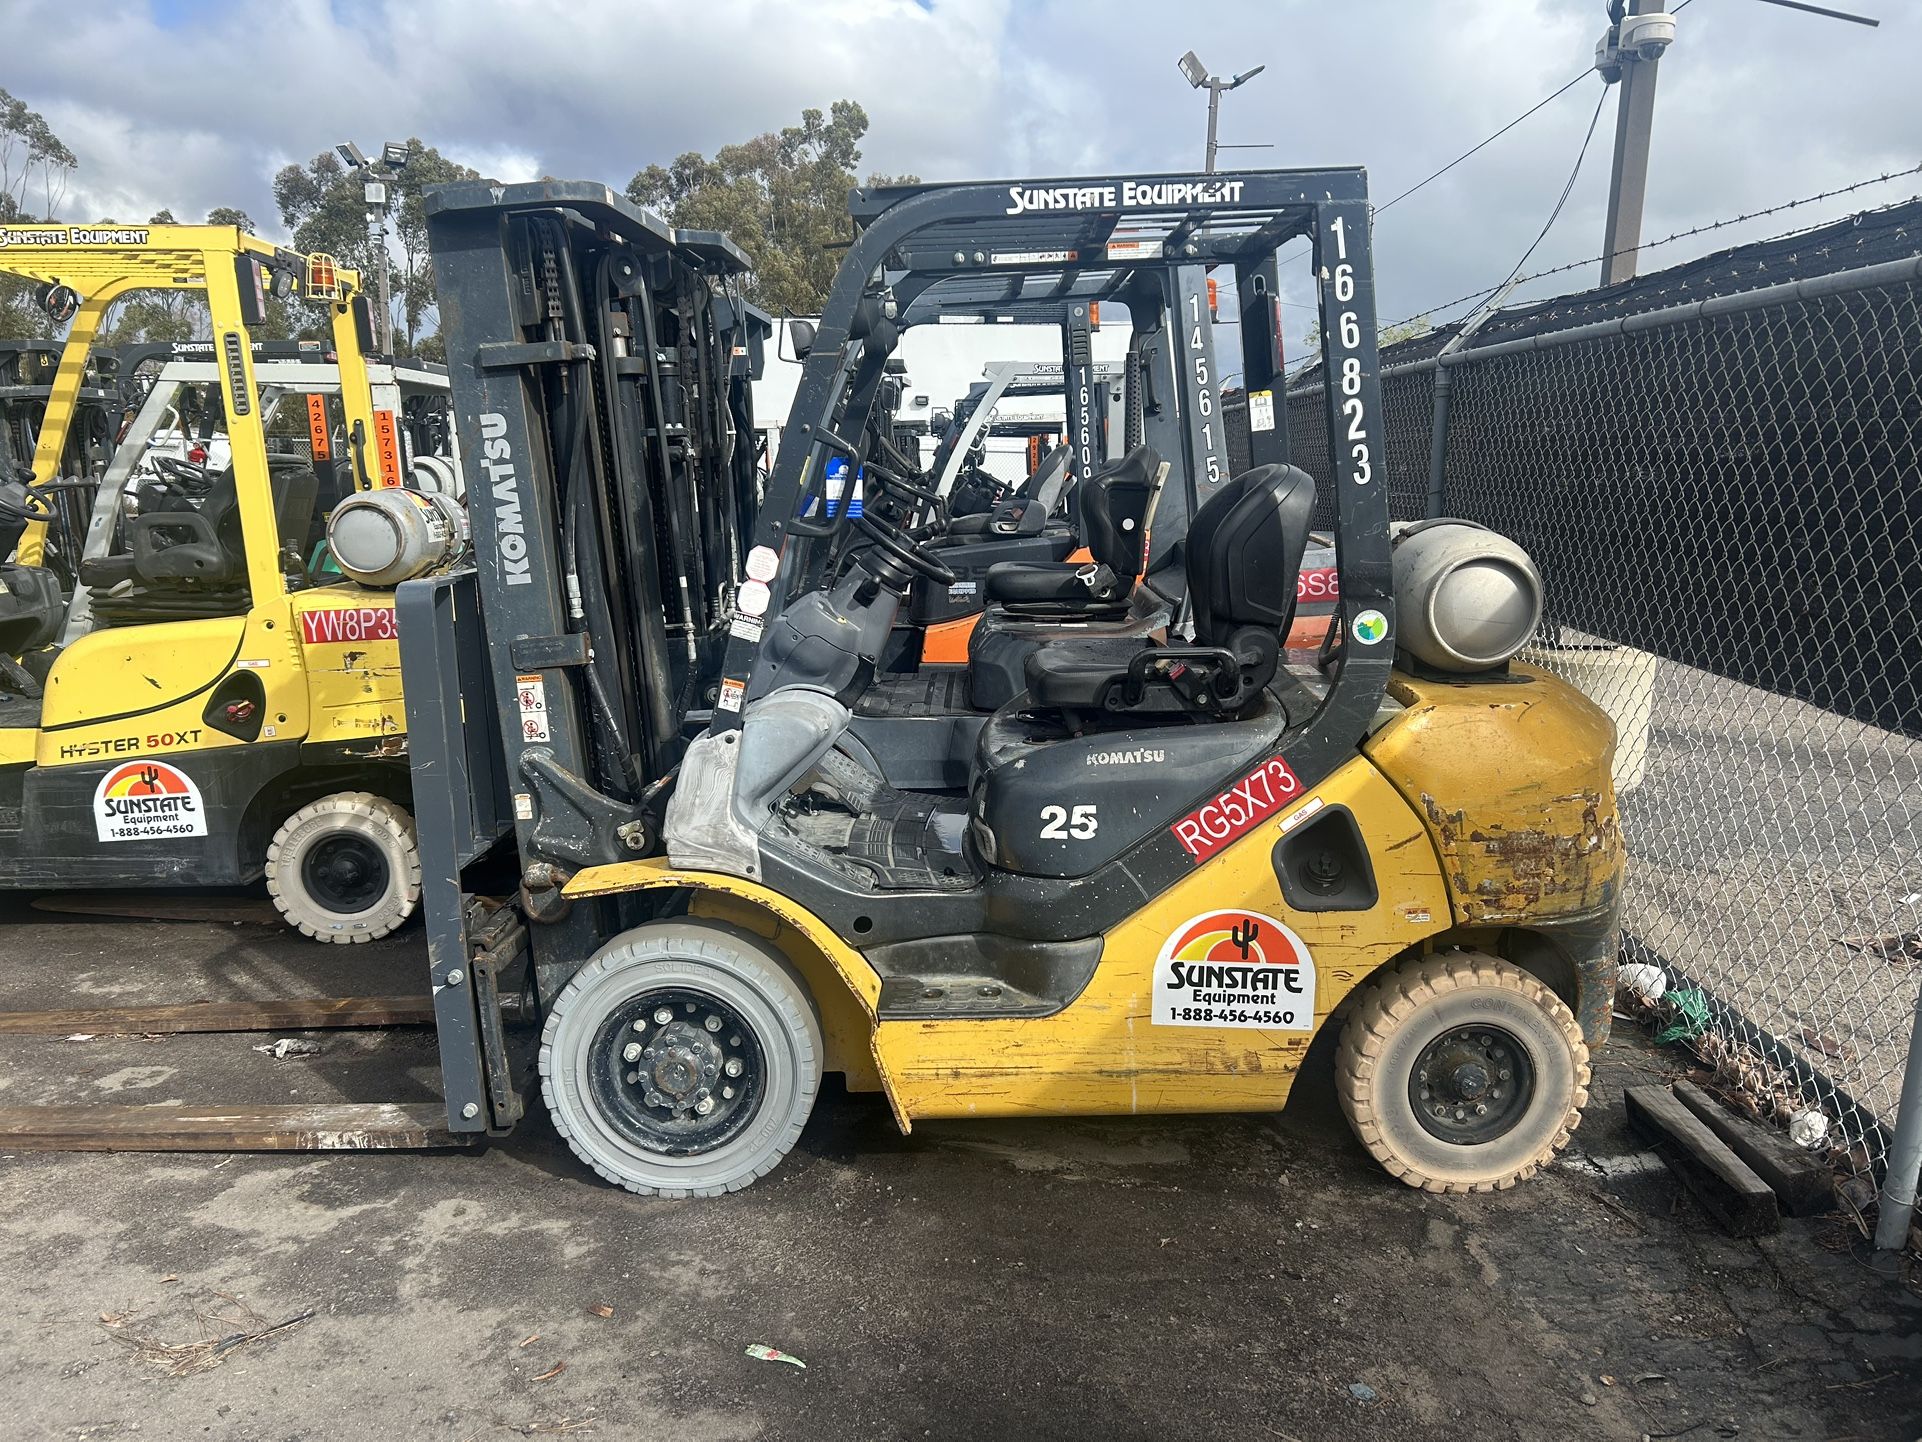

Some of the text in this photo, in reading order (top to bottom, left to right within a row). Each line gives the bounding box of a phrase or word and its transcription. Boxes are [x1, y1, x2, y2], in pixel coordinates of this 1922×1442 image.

[1006, 181, 1244, 215] SUNSTATE EQUIPMENT
[69, 227, 149, 244] EQUIPMENT
[1331, 216, 1372, 486] 166823
[1189, 294, 1221, 484] 145615
[380, 412, 396, 486] 157316
[480, 412, 532, 586] KOMATSU
[61, 729, 202, 759] HYSTER 50XT
[1086, 748, 1165, 766] KOMATSU
[104, 795, 196, 818] SUNSTATE
[123, 813, 180, 826] Equipment
[1176, 761, 1296, 856] RG5X73
[1293, 809, 1308, 821] GAS
[110, 823, 194, 838] 1-888-456-4560
[1040, 805, 1099, 840] 25
[1167, 961, 1303, 994] SUNSTATE
[1192, 989, 1276, 1006] Equipment
[1170, 1007, 1295, 1024] 1-888-456-4560
